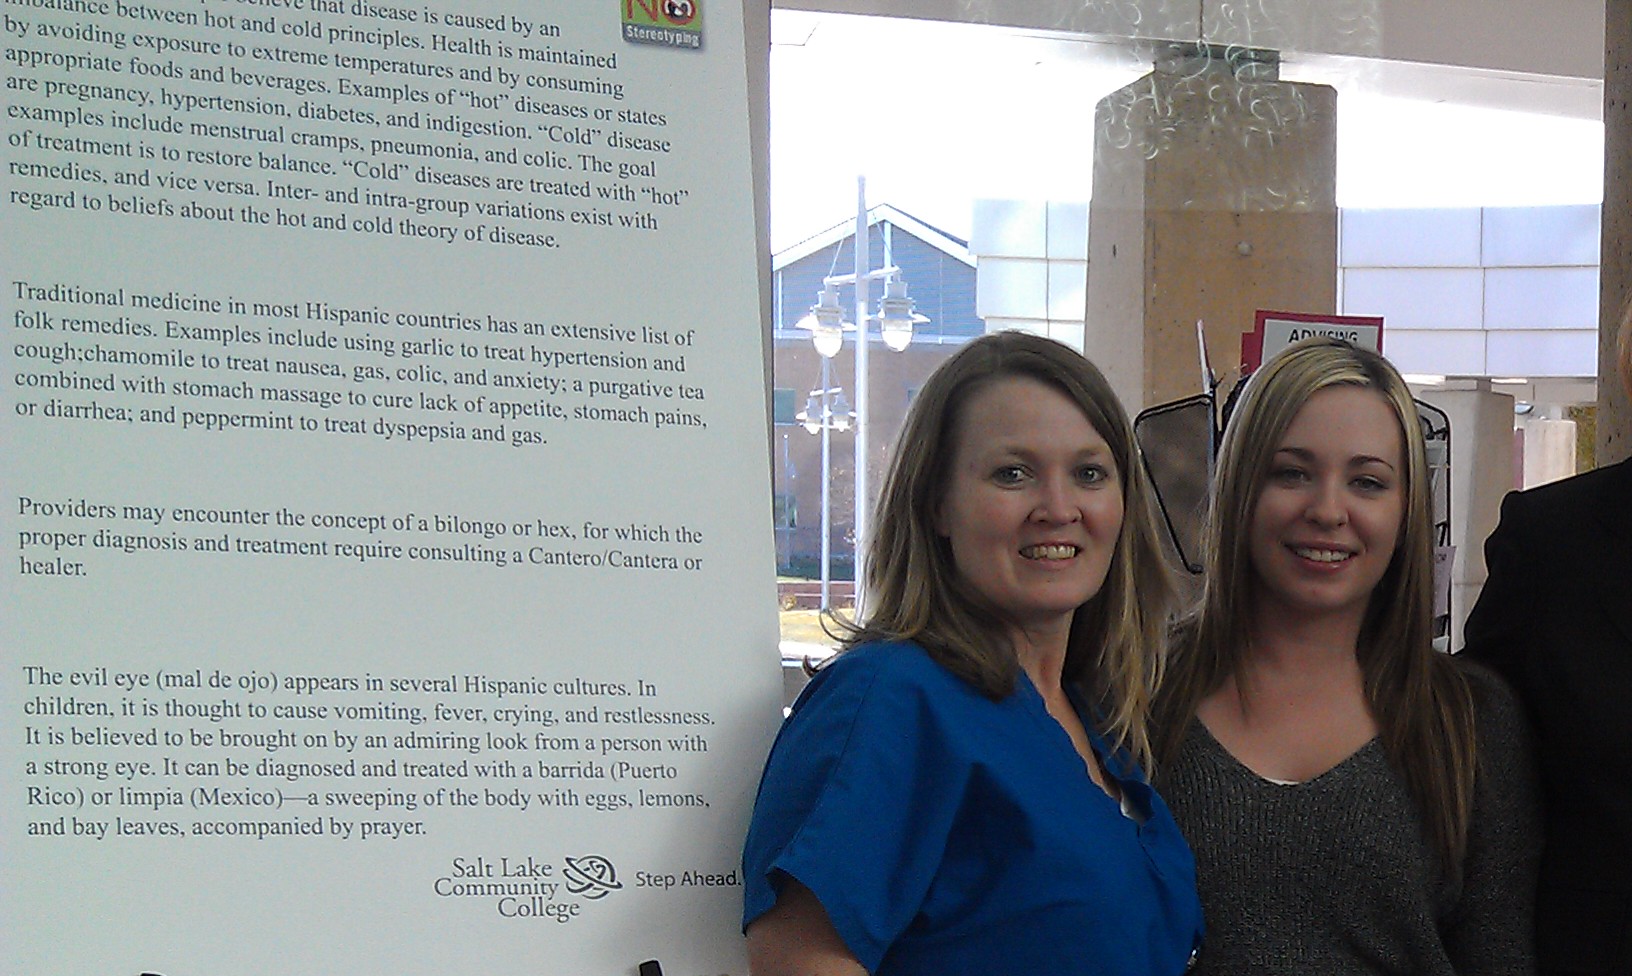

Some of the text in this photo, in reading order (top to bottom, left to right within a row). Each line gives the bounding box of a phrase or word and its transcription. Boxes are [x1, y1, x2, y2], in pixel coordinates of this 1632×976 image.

[626, 25, 700, 46] Stereotyping
[11, 281, 695, 346] Traditional medicine in most Hispanic countries has an extensive list of
[18, 529, 703, 570] proper diagnosis and treatment require consulting a Cantero/Cantera or
[18, 555, 87, 576] healer.
[27, 816, 427, 841] and bay leaves, accompanied by prayer.
[451, 856, 552, 878] Salt Lake
[434, 877, 560, 901] Community
[636, 868, 742, 891] Step Ahead.
[497, 896, 580, 924] College
